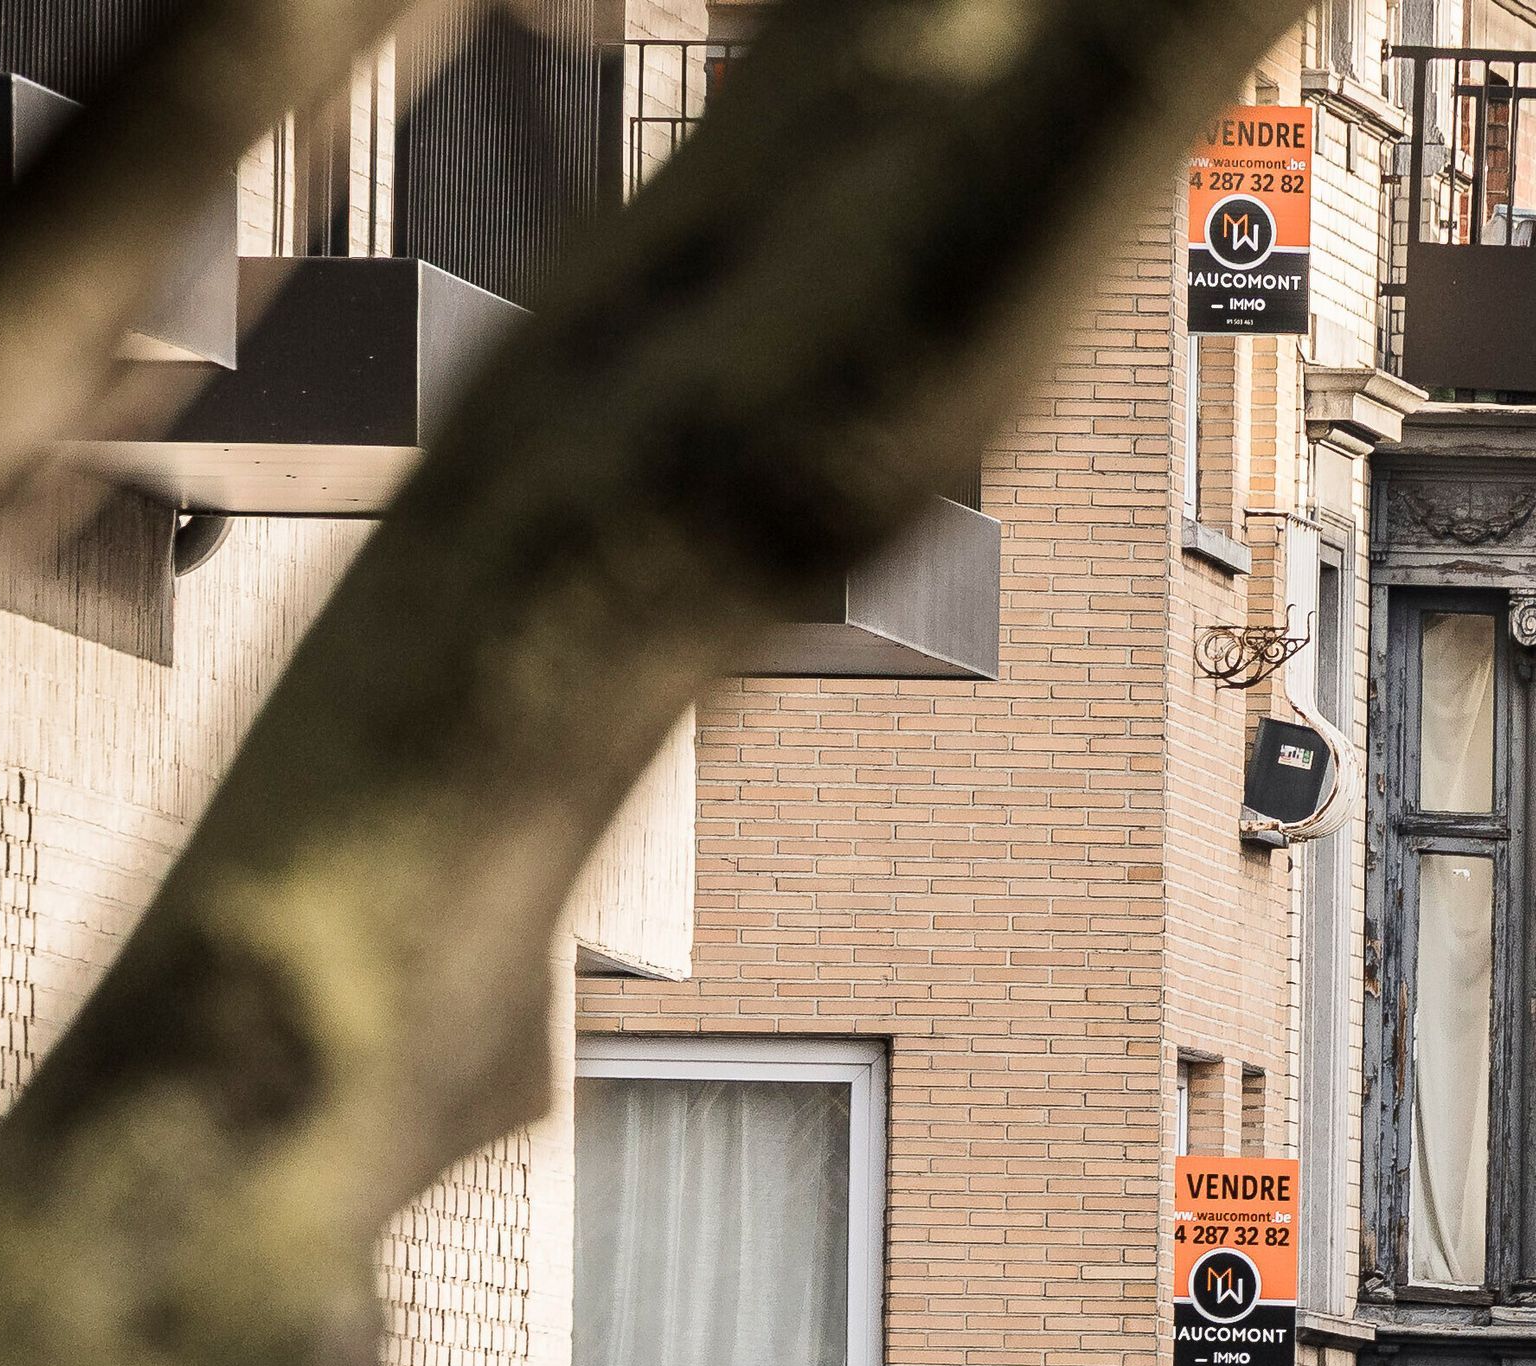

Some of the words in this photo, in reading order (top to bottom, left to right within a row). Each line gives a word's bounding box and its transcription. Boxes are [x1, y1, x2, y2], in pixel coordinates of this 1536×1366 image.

[1206, 119, 1305, 148] VENDRE
[1190, 158, 1306, 170] ww.waucomont.be
[1189, 172, 1202, 190] 4
[1209, 172, 1245, 191] 287
[1250, 173, 1274, 192] 32
[1281, 174, 1304, 194] 82
[1229, 297, 1266, 311] IMMO
[1186, 1173, 1291, 1201] VENDRE
[1174, 1211, 1292, 1223] ww.waucomont.be
[1174, 1225, 1186, 1243] 4
[1192, 1226, 1229, 1245] 287
[1234, 1227, 1259, 1246] 32
[1265, 1228, 1290, 1247] 82
[1173, 1326, 1287, 1343] AUCOMONT
[1213, 1351, 1251, 1365] IMMO
